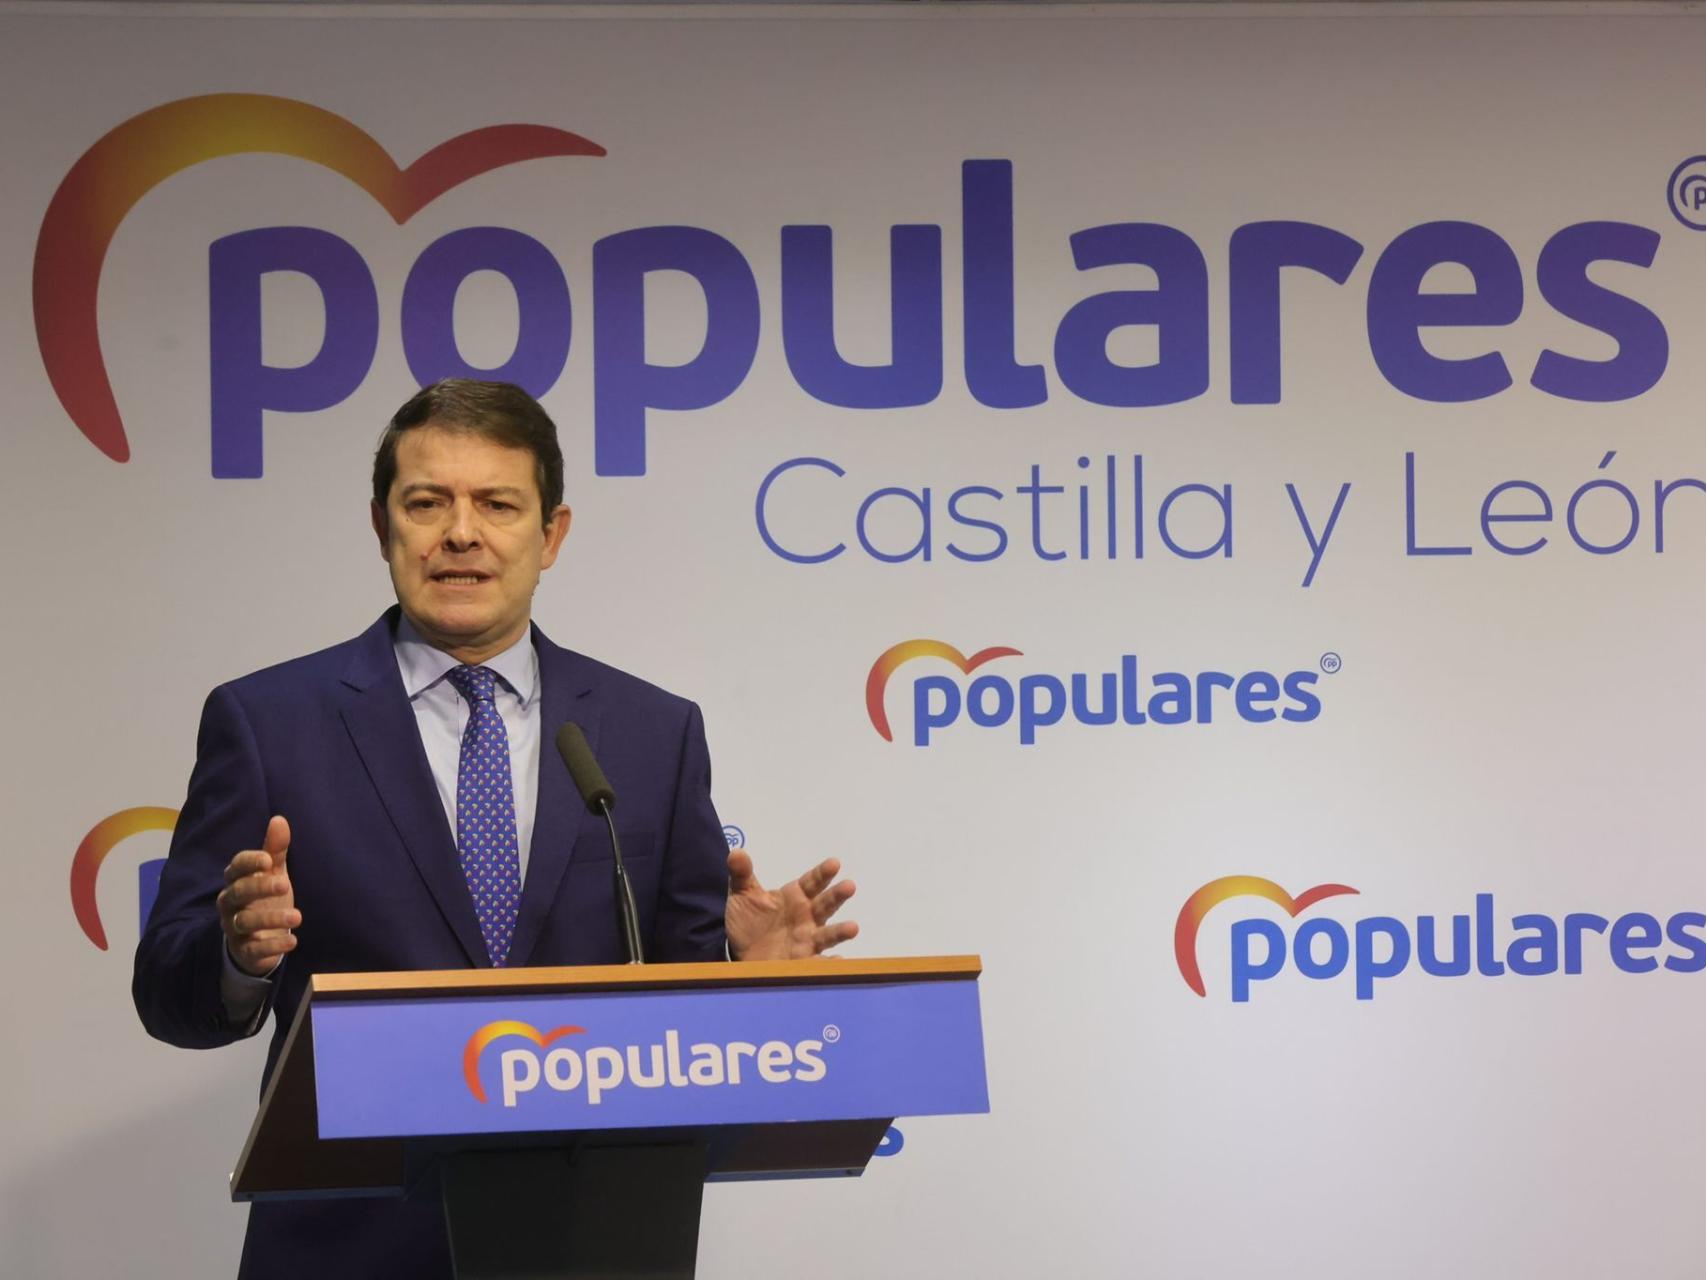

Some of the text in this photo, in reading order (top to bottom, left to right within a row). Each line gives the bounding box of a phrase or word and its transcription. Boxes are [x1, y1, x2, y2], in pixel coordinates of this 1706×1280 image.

[209, 159, 1669, 479] populares
[755, 451, 1706, 587] Castilla y León
[914, 655, 1320, 746] populares
[1231, 893, 1706, 1003] populares
[501, 1030, 827, 1107] populares
